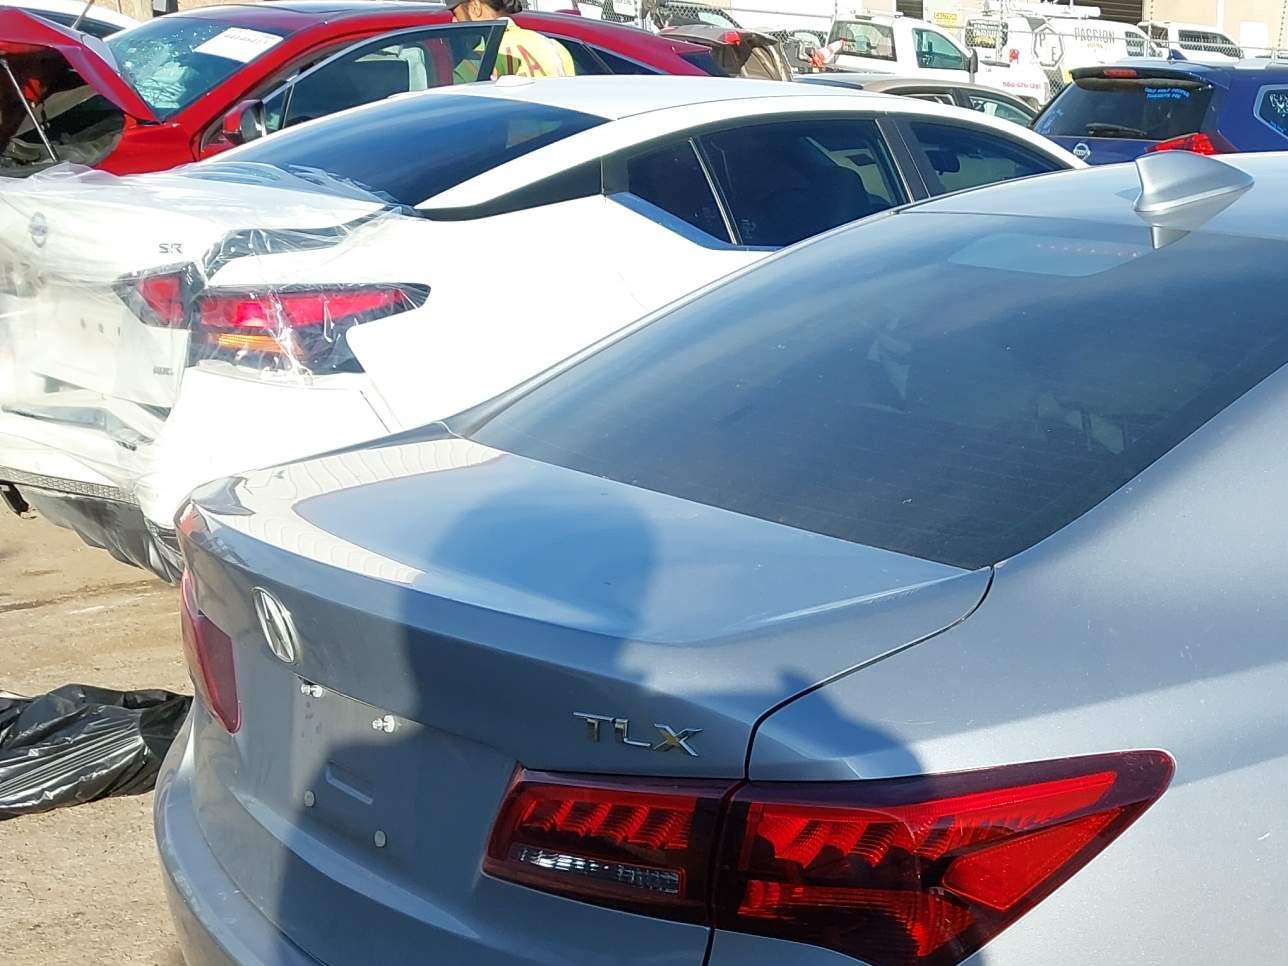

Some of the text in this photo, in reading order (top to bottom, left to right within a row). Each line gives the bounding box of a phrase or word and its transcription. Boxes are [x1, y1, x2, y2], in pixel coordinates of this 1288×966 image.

[1074, 27, 1115, 45] PASSION
[158, 242, 184, 254] SR
[572, 711, 703, 757] TLX
